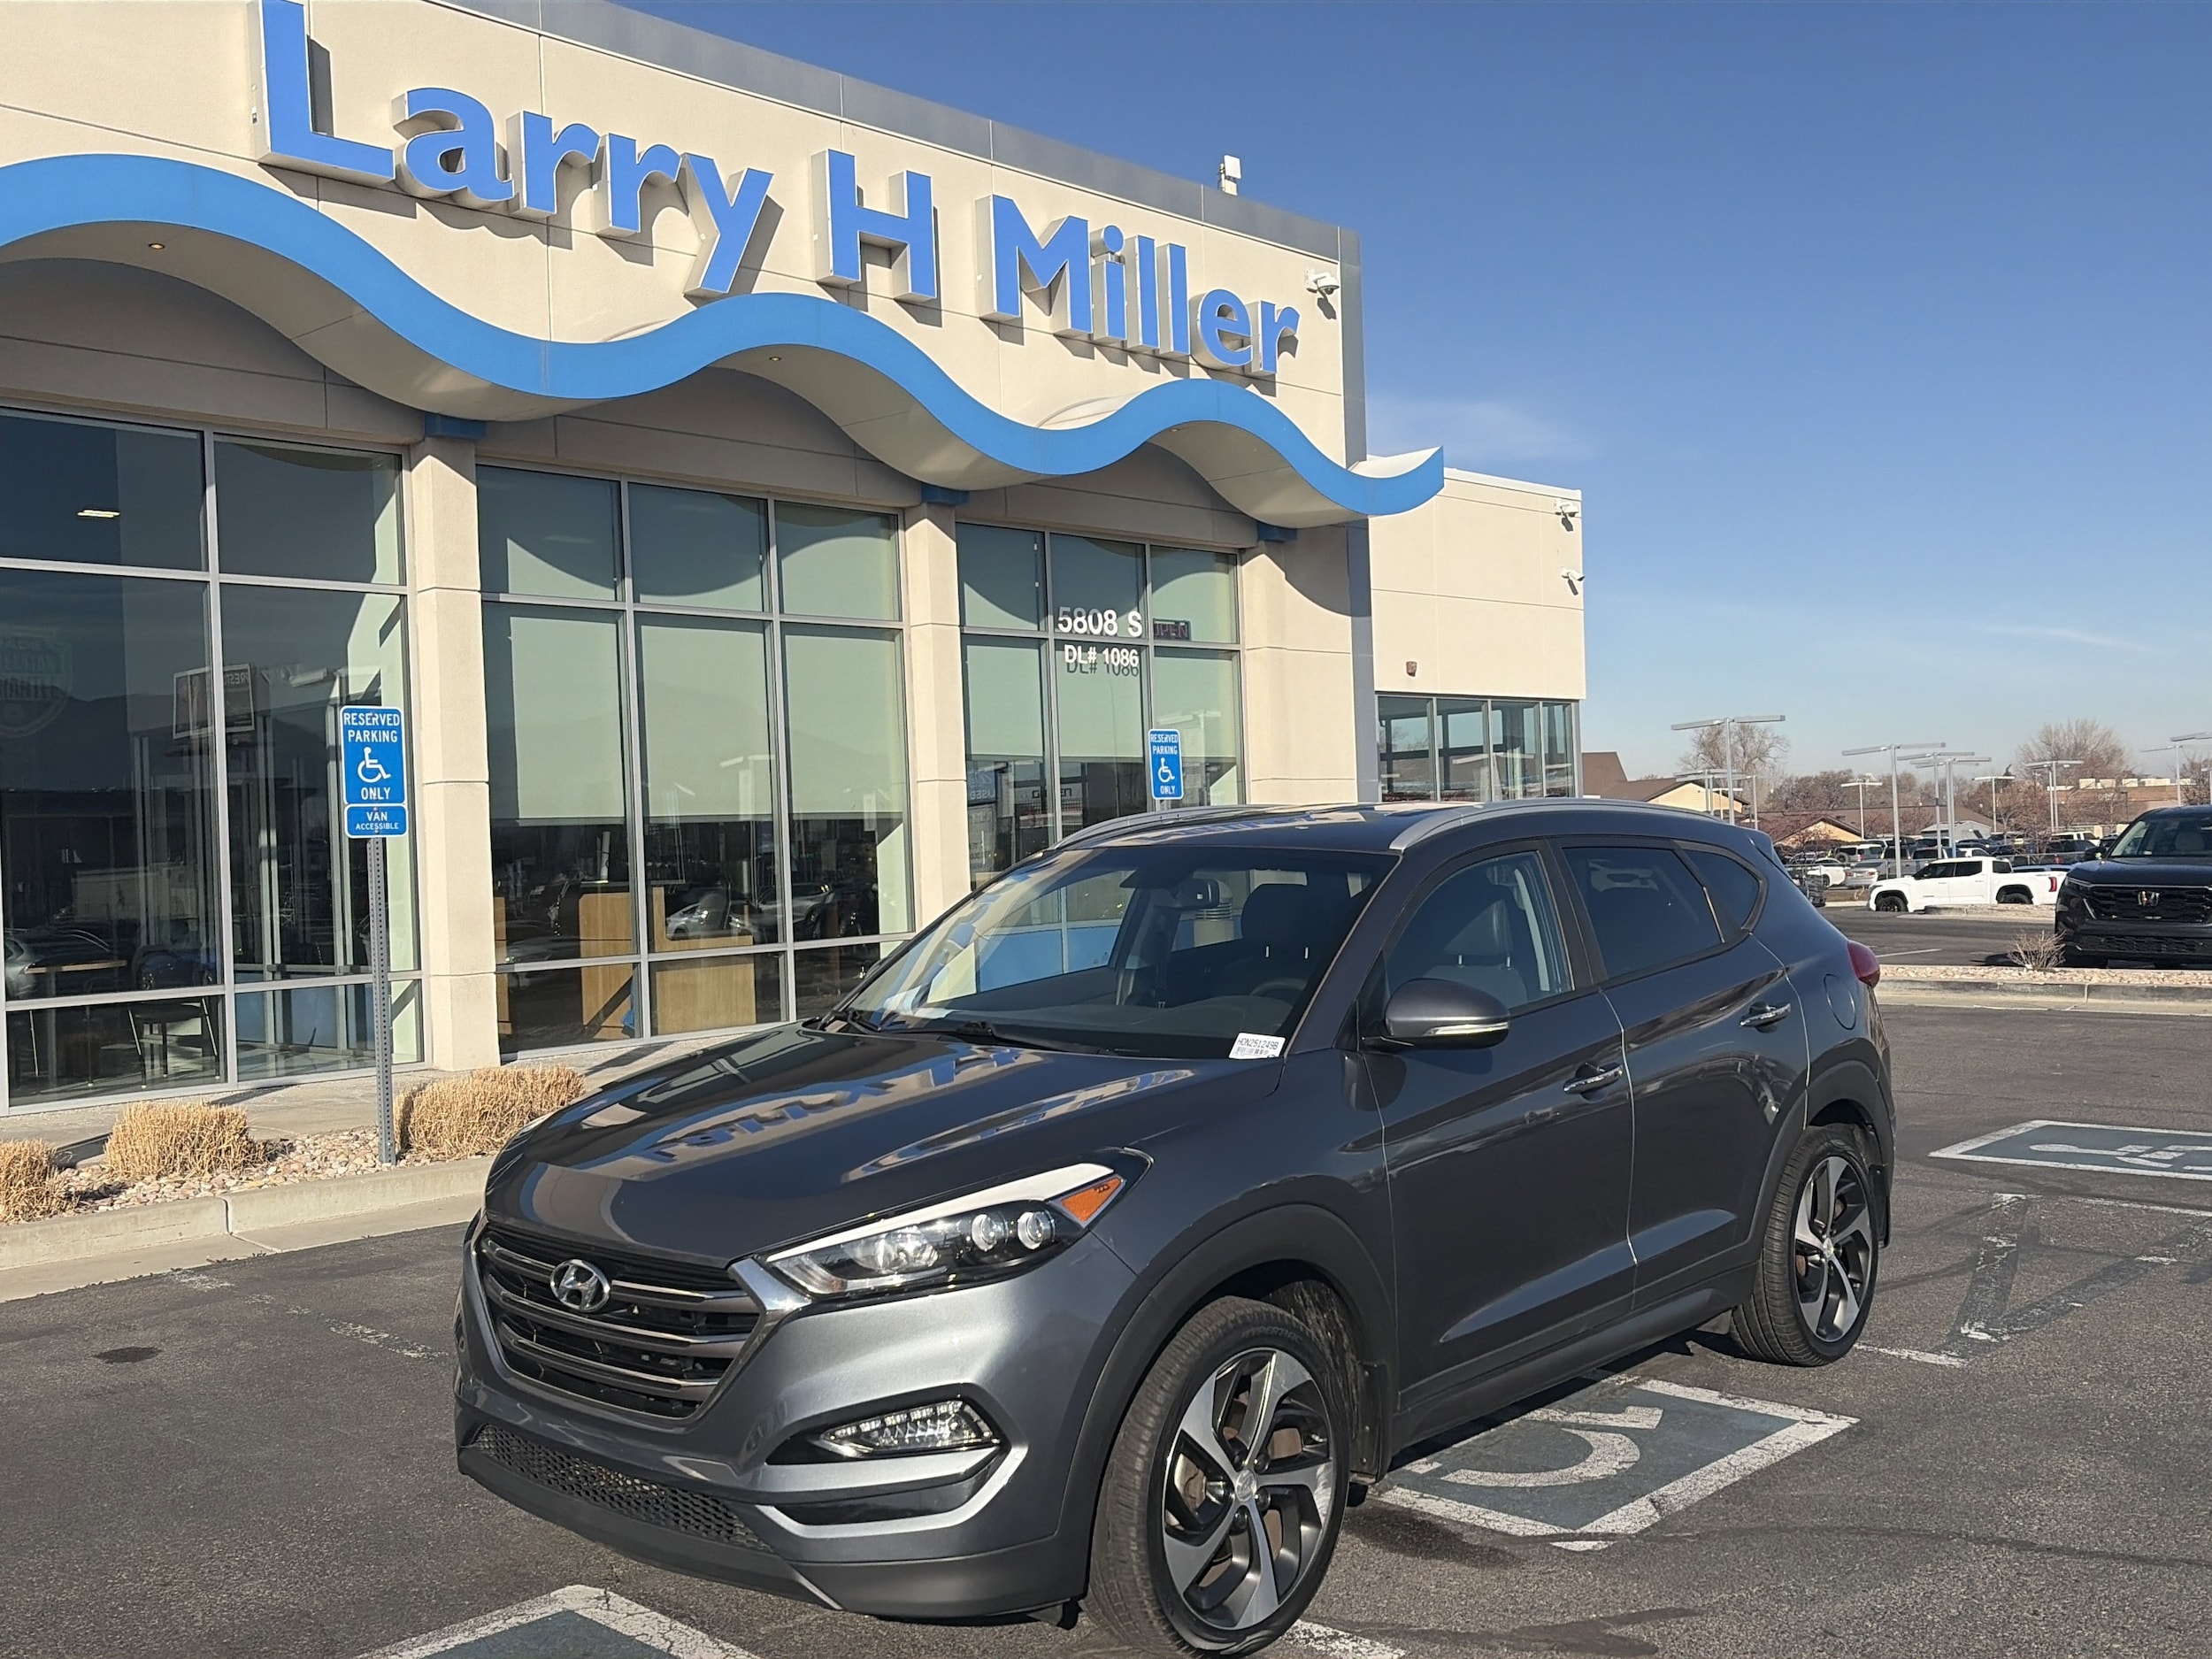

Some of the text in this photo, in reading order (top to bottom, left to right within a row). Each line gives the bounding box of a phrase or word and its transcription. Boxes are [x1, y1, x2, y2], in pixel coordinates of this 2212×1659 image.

[257, 0, 1301, 376] Larry H Miller
[1057, 606, 1143, 638] 5808 S
[1064, 644, 1140, 667] DL# 1086
[343, 712, 401, 726] RESERVED
[348, 730, 398, 743] PARKING
[1150, 733, 1179, 743] RESERVED
[1152, 745, 1178, 755] PARKING
[360, 787, 391, 801] ONLY
[1160, 785, 1176, 795] ONLY
[366, 811, 388, 822] VAN
[355, 822, 399, 831] ACCESSIBLE
